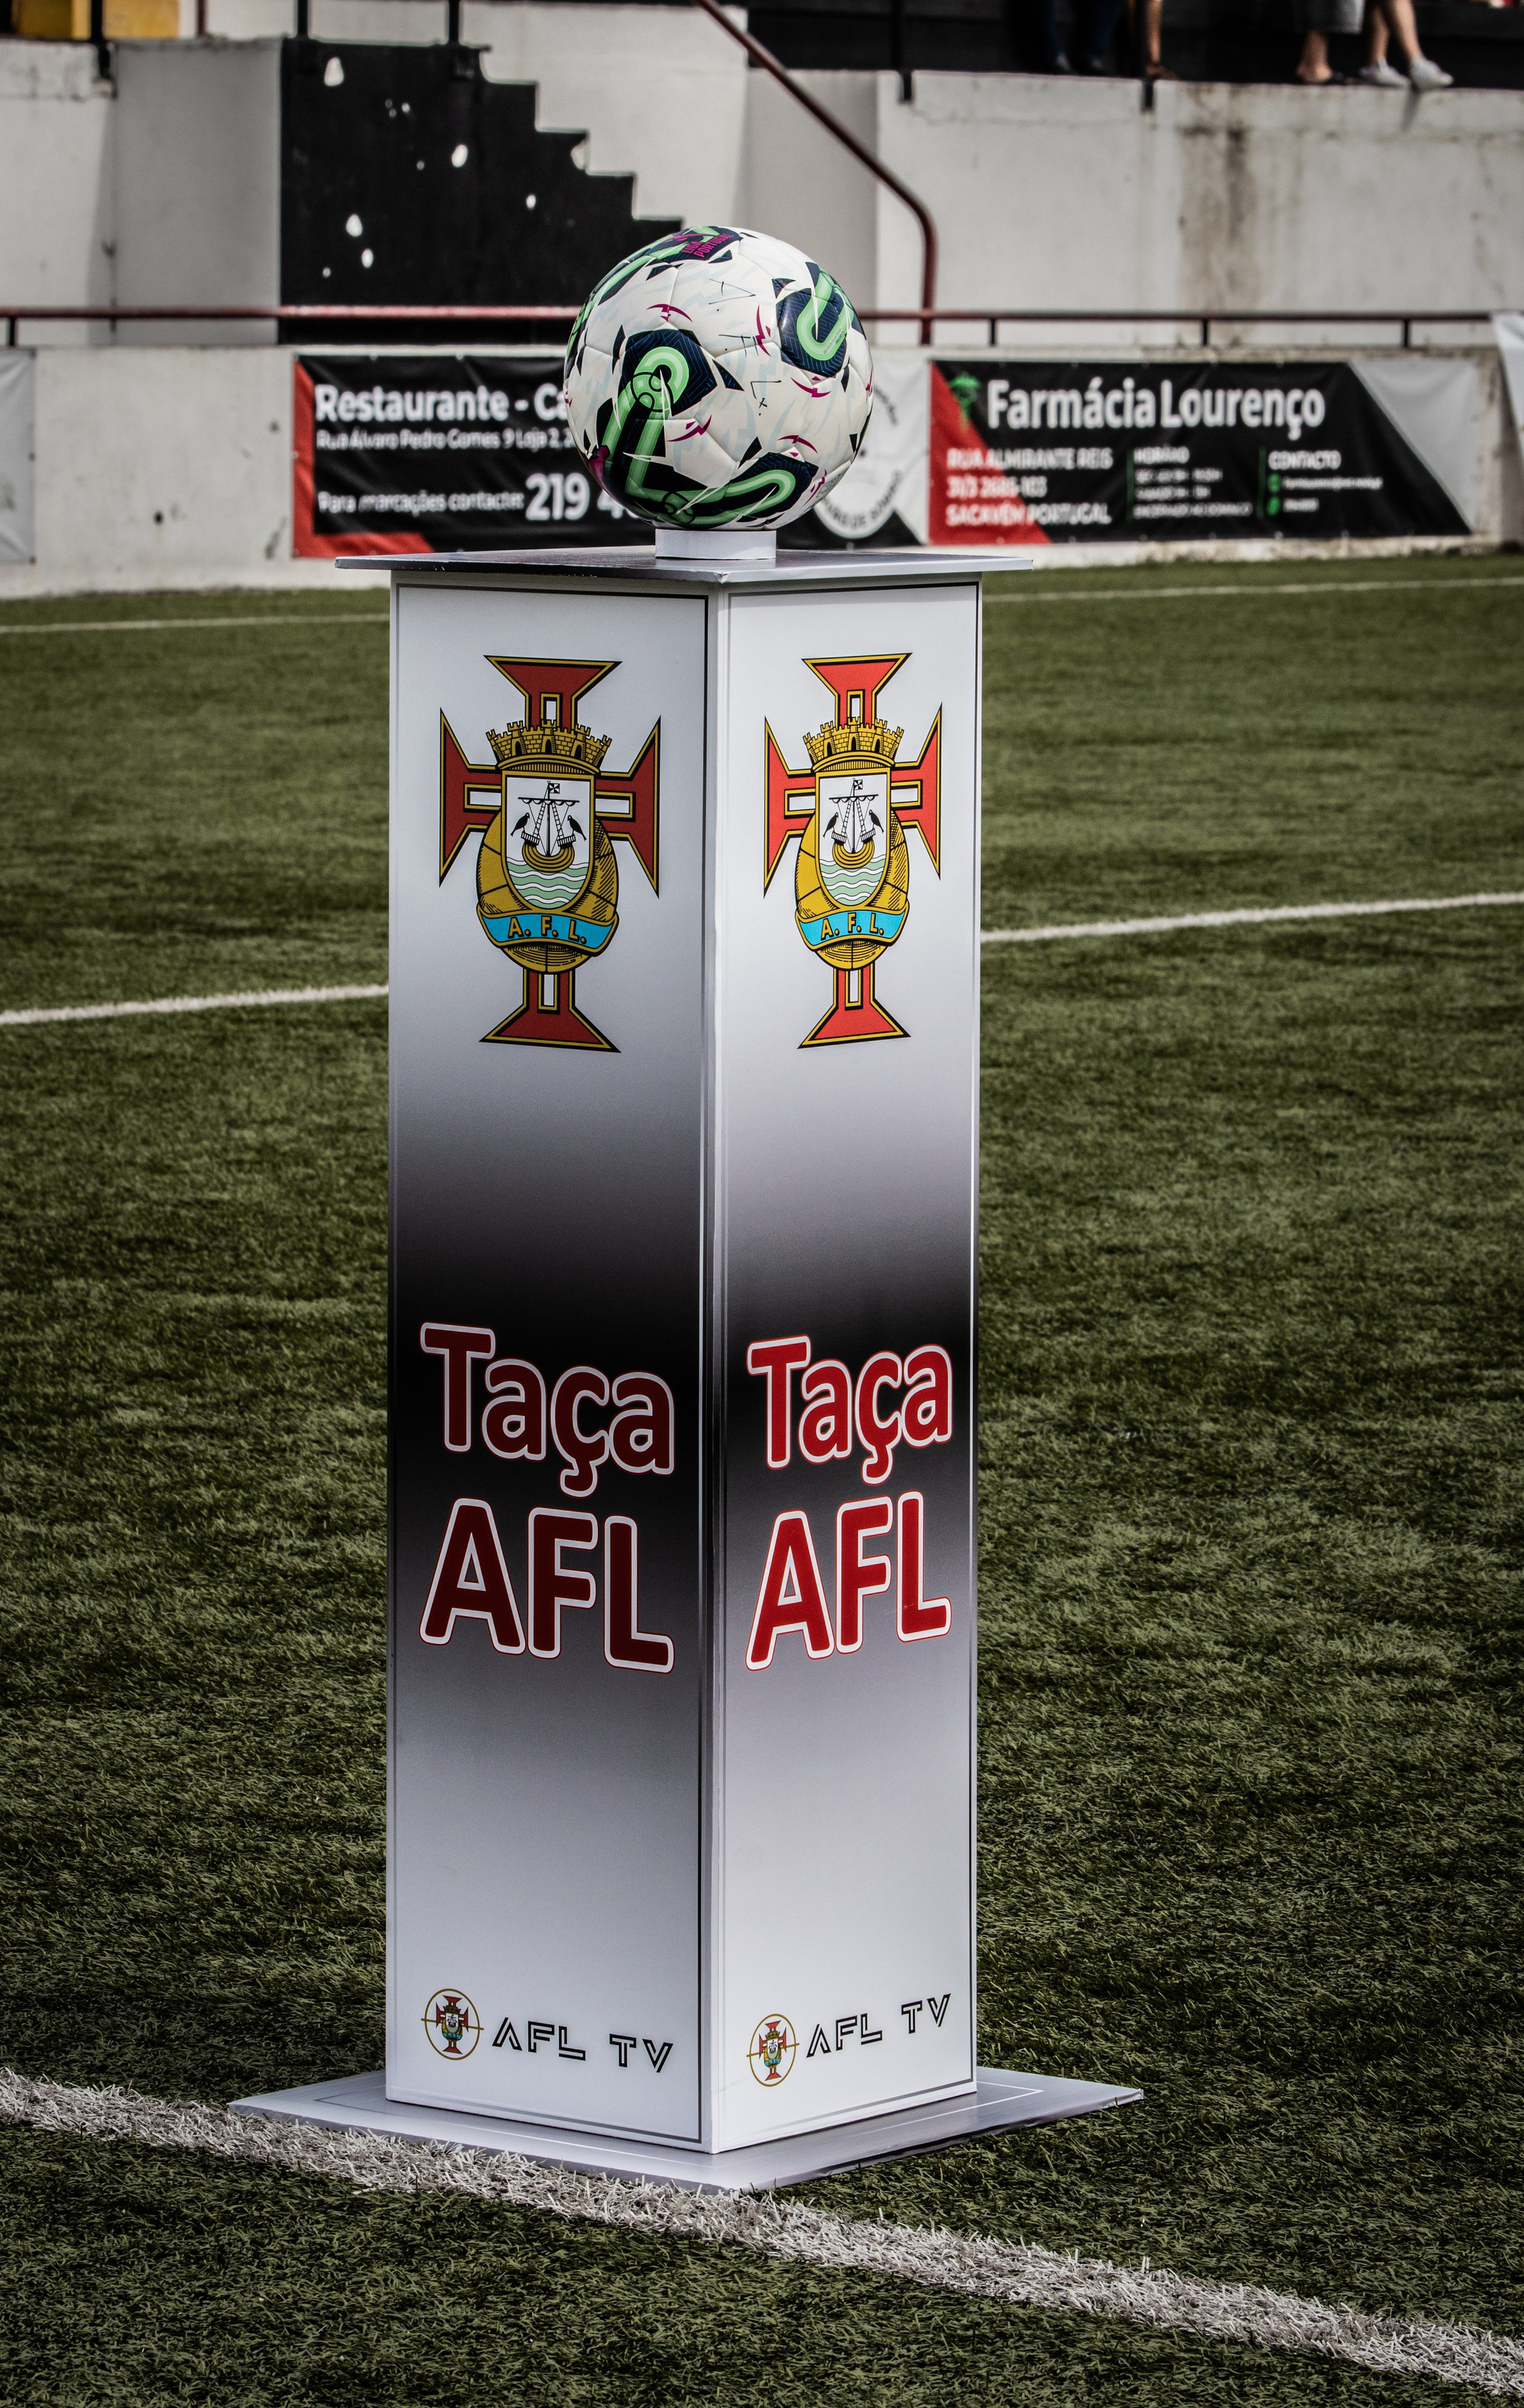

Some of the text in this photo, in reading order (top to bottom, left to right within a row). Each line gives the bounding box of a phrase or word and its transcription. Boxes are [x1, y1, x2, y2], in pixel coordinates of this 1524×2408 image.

[680, 241, 704, 254] LIGA
[694, 233, 734, 257] PORTUGAL
[315, 384, 509, 421] Restaurante
[987, 376, 1325, 441] Farmácia Lourenço
[316, 429, 349, 450] Rua
[349, 425, 399, 450] Álvaro
[400, 428, 446, 450] Pedro
[447, 428, 501, 450] Gomes
[516, 427, 548, 453] Loja
[947, 447, 1113, 470] RUA ALMIRANTE REIS
[1268, 450, 1341, 470] CONTACTO
[318, 491, 356, 513] Para
[358, 489, 446, 517] marcações
[525, 473, 590, 520] 219
[946, 501, 1026, 526] SACAVÉM
[1026, 503, 1112, 525] PORTUGAL
[420, 1322, 674, 1498] Taça
[747, 1335, 952, 1484] Taça
[420, 1497, 674, 1674] AFL
[745, 1490, 952, 1671] AFL
[492, 2017, 673, 2073] AFL TV
[806, 1993, 951, 2058] AFL TV
